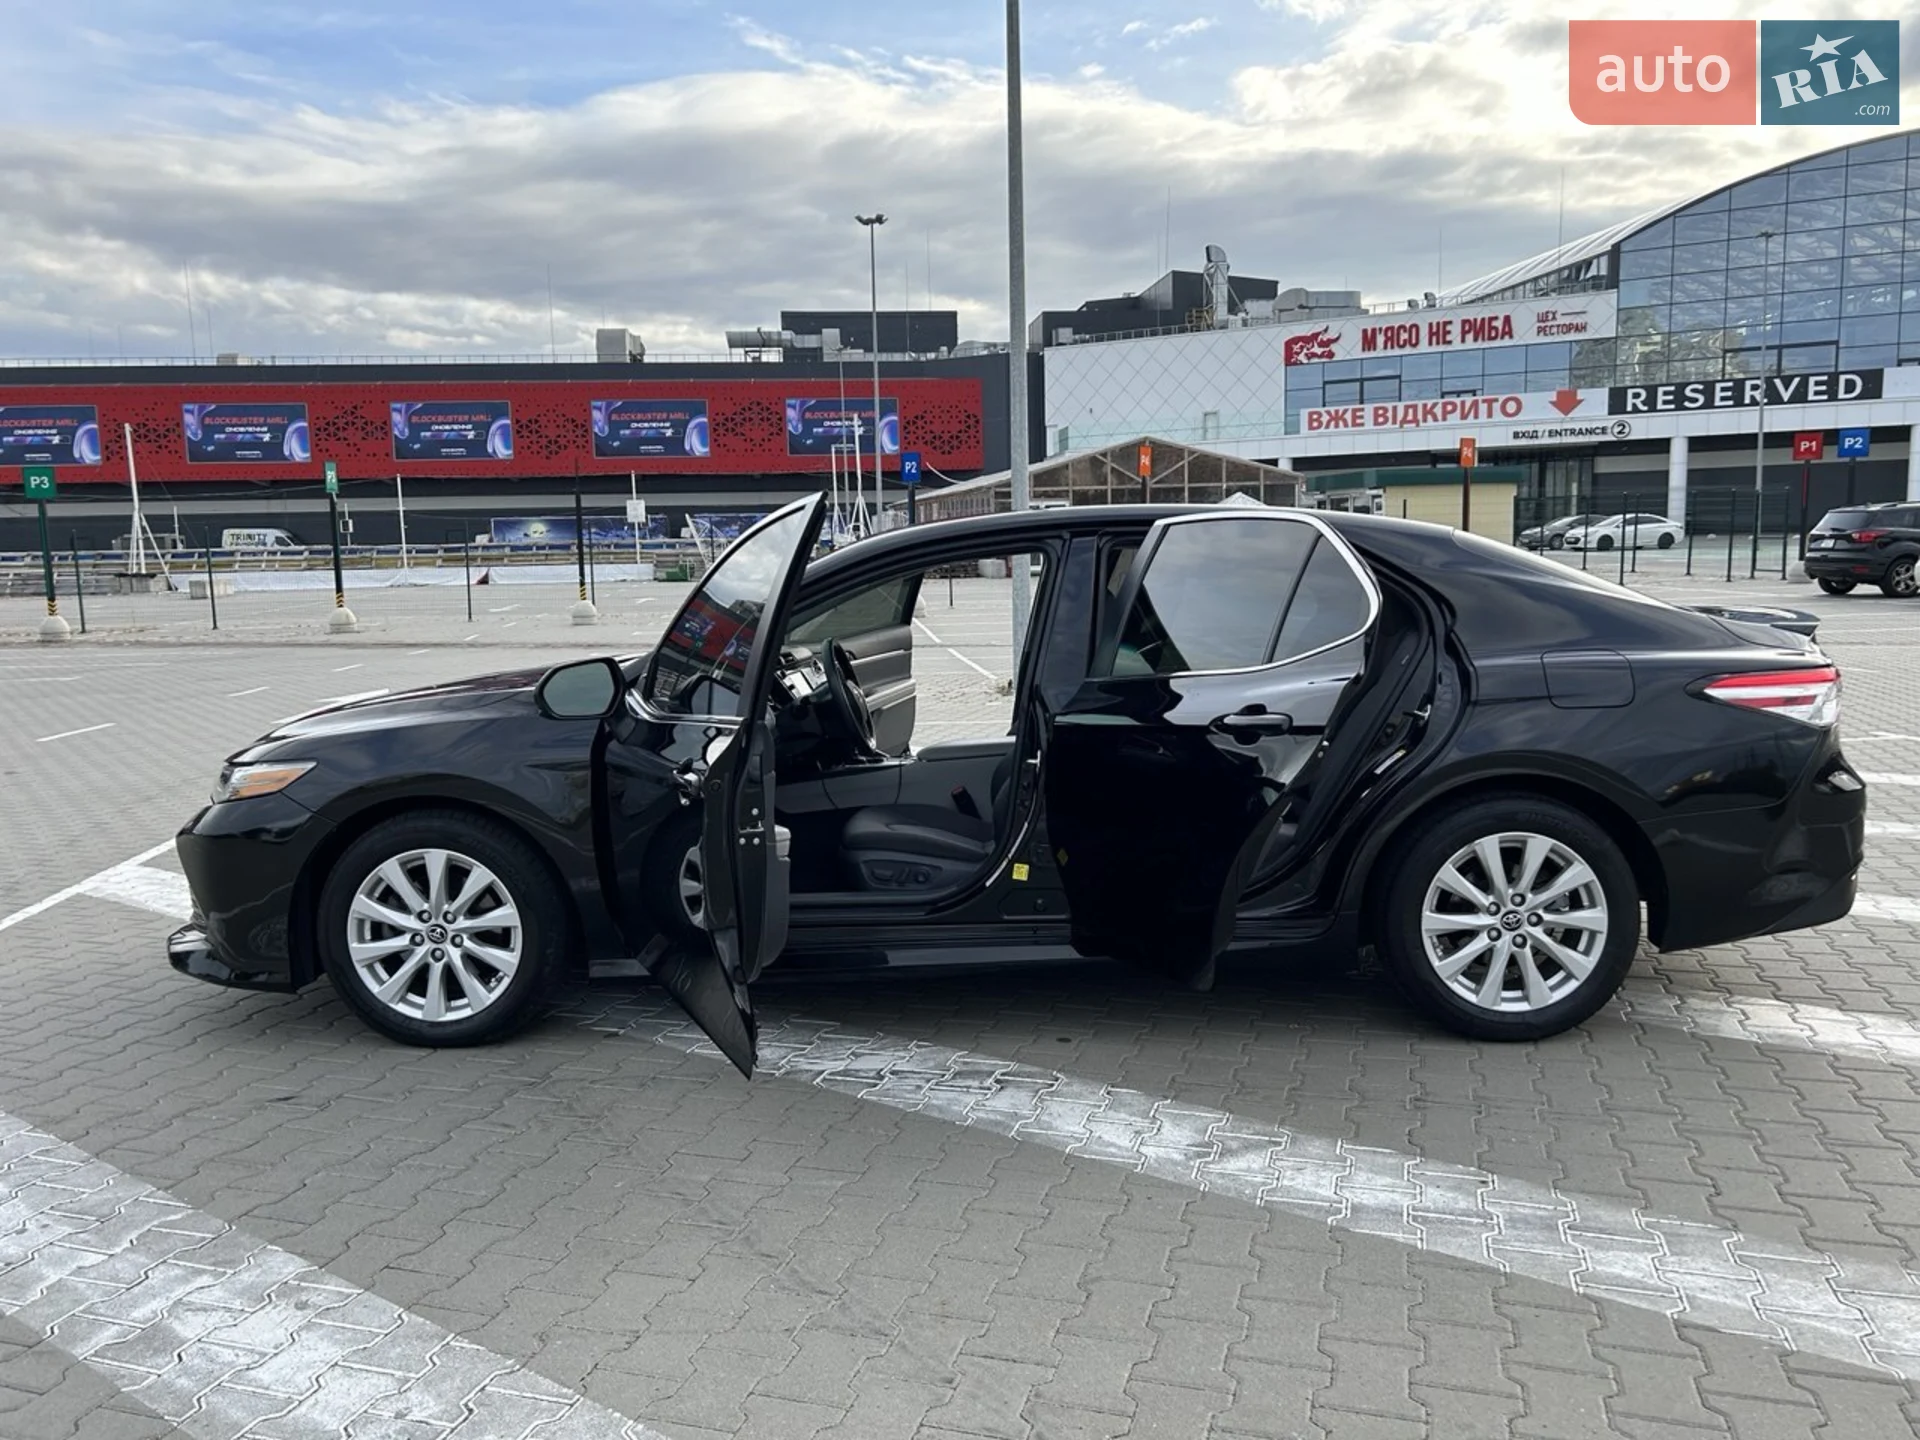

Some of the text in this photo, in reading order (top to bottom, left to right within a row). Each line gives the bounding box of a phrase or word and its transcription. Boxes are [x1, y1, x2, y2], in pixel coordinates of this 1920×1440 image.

[1537, 310, 1558, 323] ЦЕХ
[1361, 315, 1514, 353] М'ЯСО НЕ РИБА
[1536, 322, 1588, 337] РЕСТОРАН
[1625, 374, 1863, 412] RESERVED
[1307, 396, 1523, 431] ВЖЕ ВІДКРИТО
[1513, 429, 1539, 439] ВХІД
[1547, 426, 1608, 438] ENTRANCE
[1800, 440, 1817, 452] P1
[1844, 437, 1863, 449] P2
[905, 461, 917, 473] P2
[30, 476, 50, 489] P3
